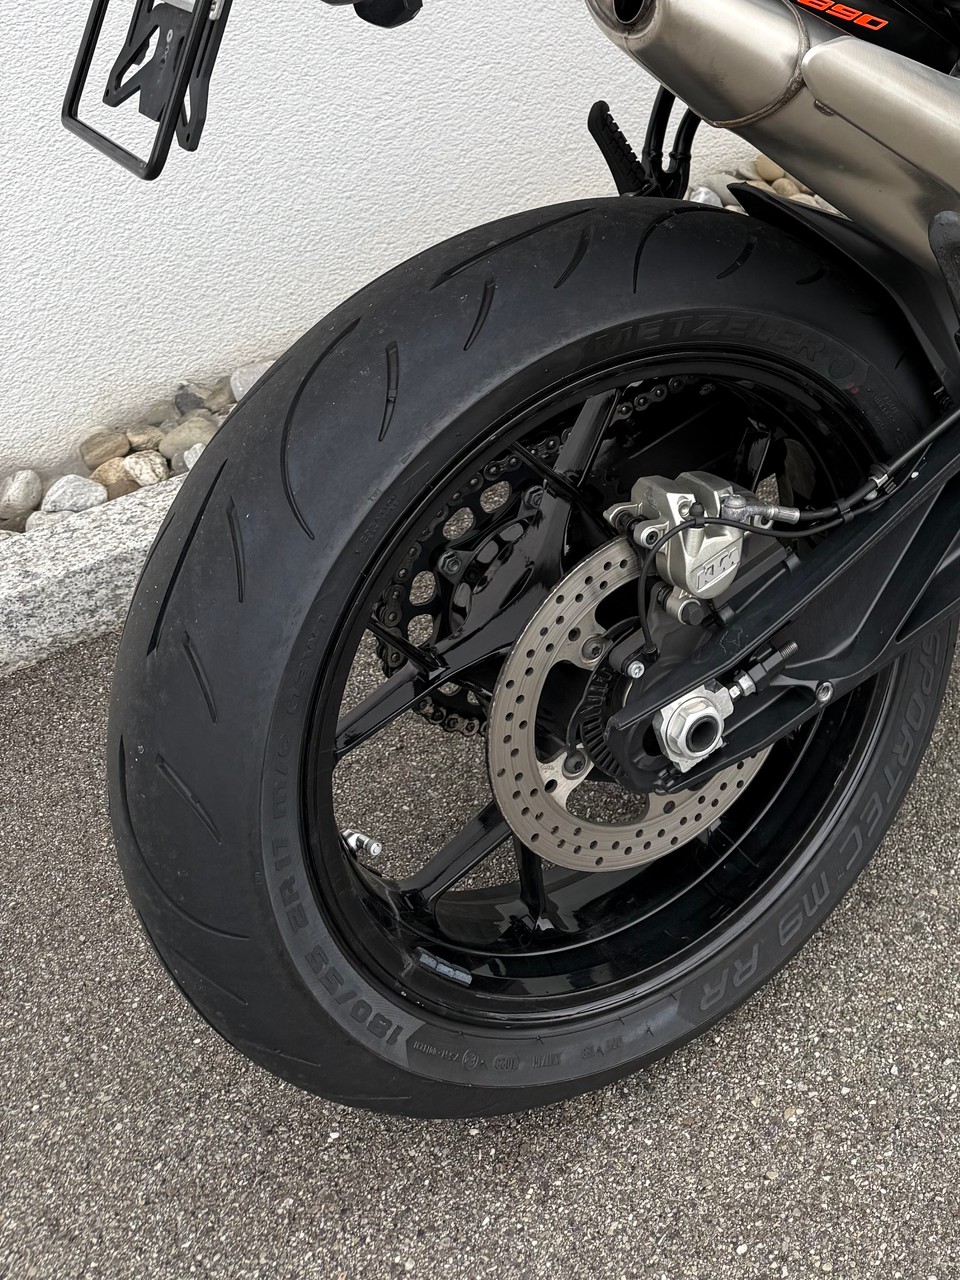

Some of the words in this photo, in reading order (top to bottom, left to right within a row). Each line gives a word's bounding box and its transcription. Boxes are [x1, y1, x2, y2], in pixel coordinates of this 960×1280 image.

[593, 314, 828, 363] METZELER
[696, 547, 740, 592] KTM
[837, 629, 941, 867] SPORTEC
[777, 871, 831, 947] M9
[304, 945, 404, 1048] 180/55
[700, 942, 760, 1011] RR
